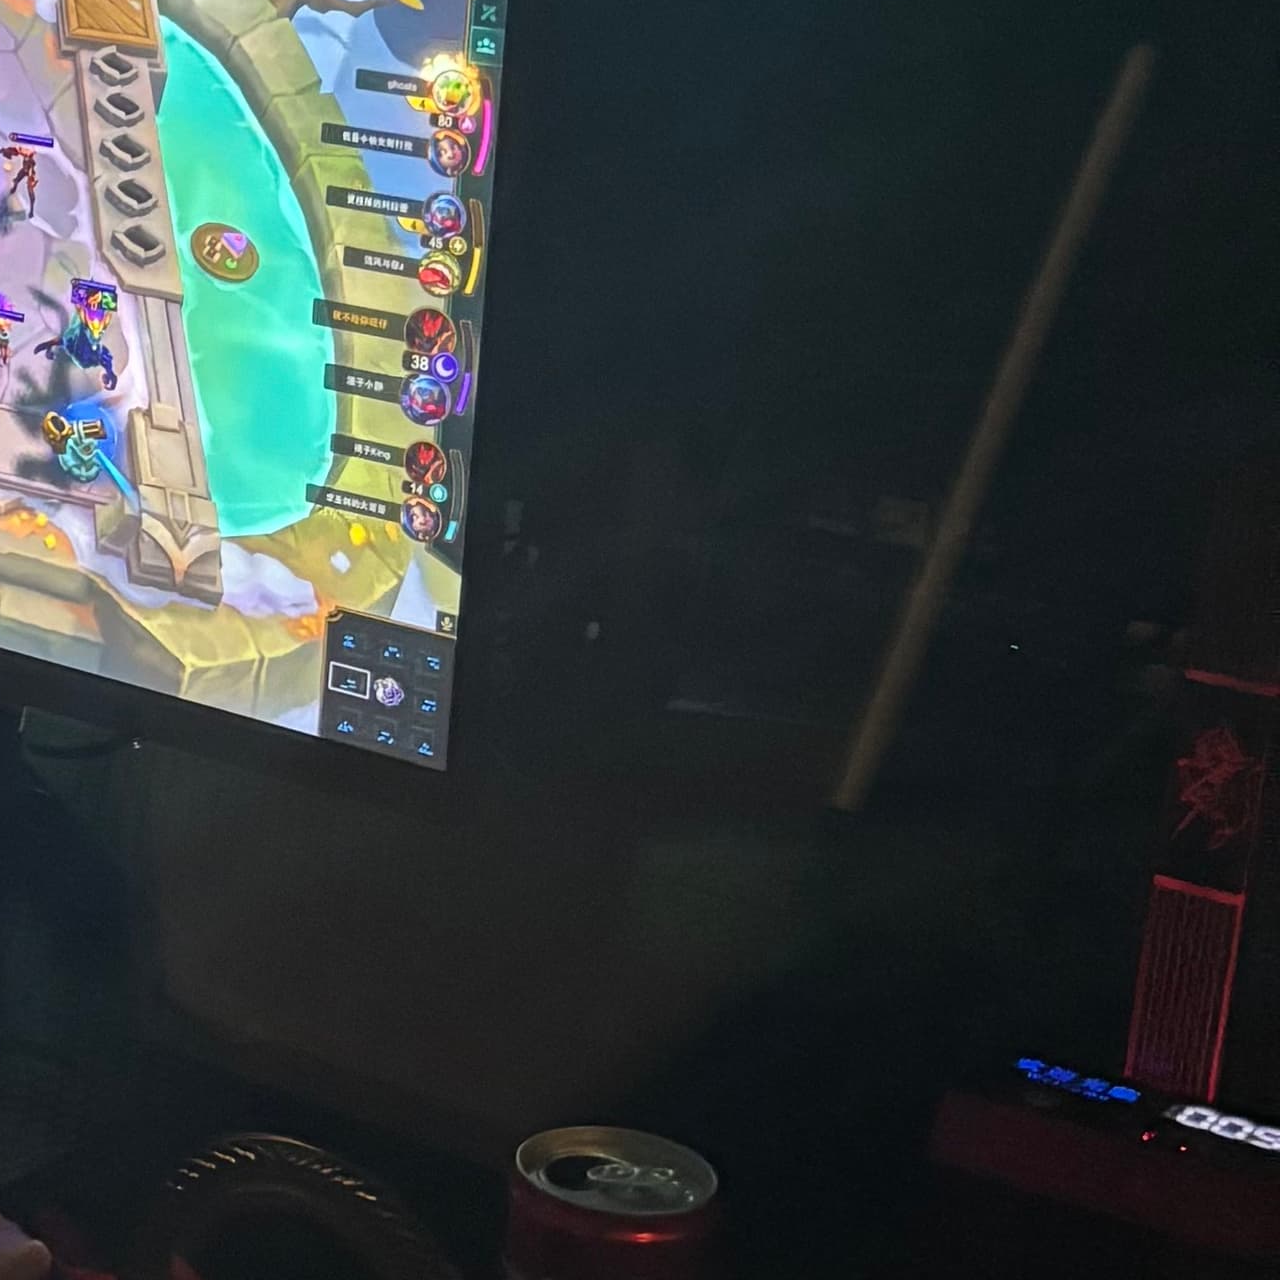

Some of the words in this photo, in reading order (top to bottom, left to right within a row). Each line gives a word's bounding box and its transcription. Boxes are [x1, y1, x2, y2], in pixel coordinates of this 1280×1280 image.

[437, 116, 453, 128] 80
[428, 237, 443, 249] 45
[410, 355, 430, 371] 38
[410, 483, 424, 494] 14
